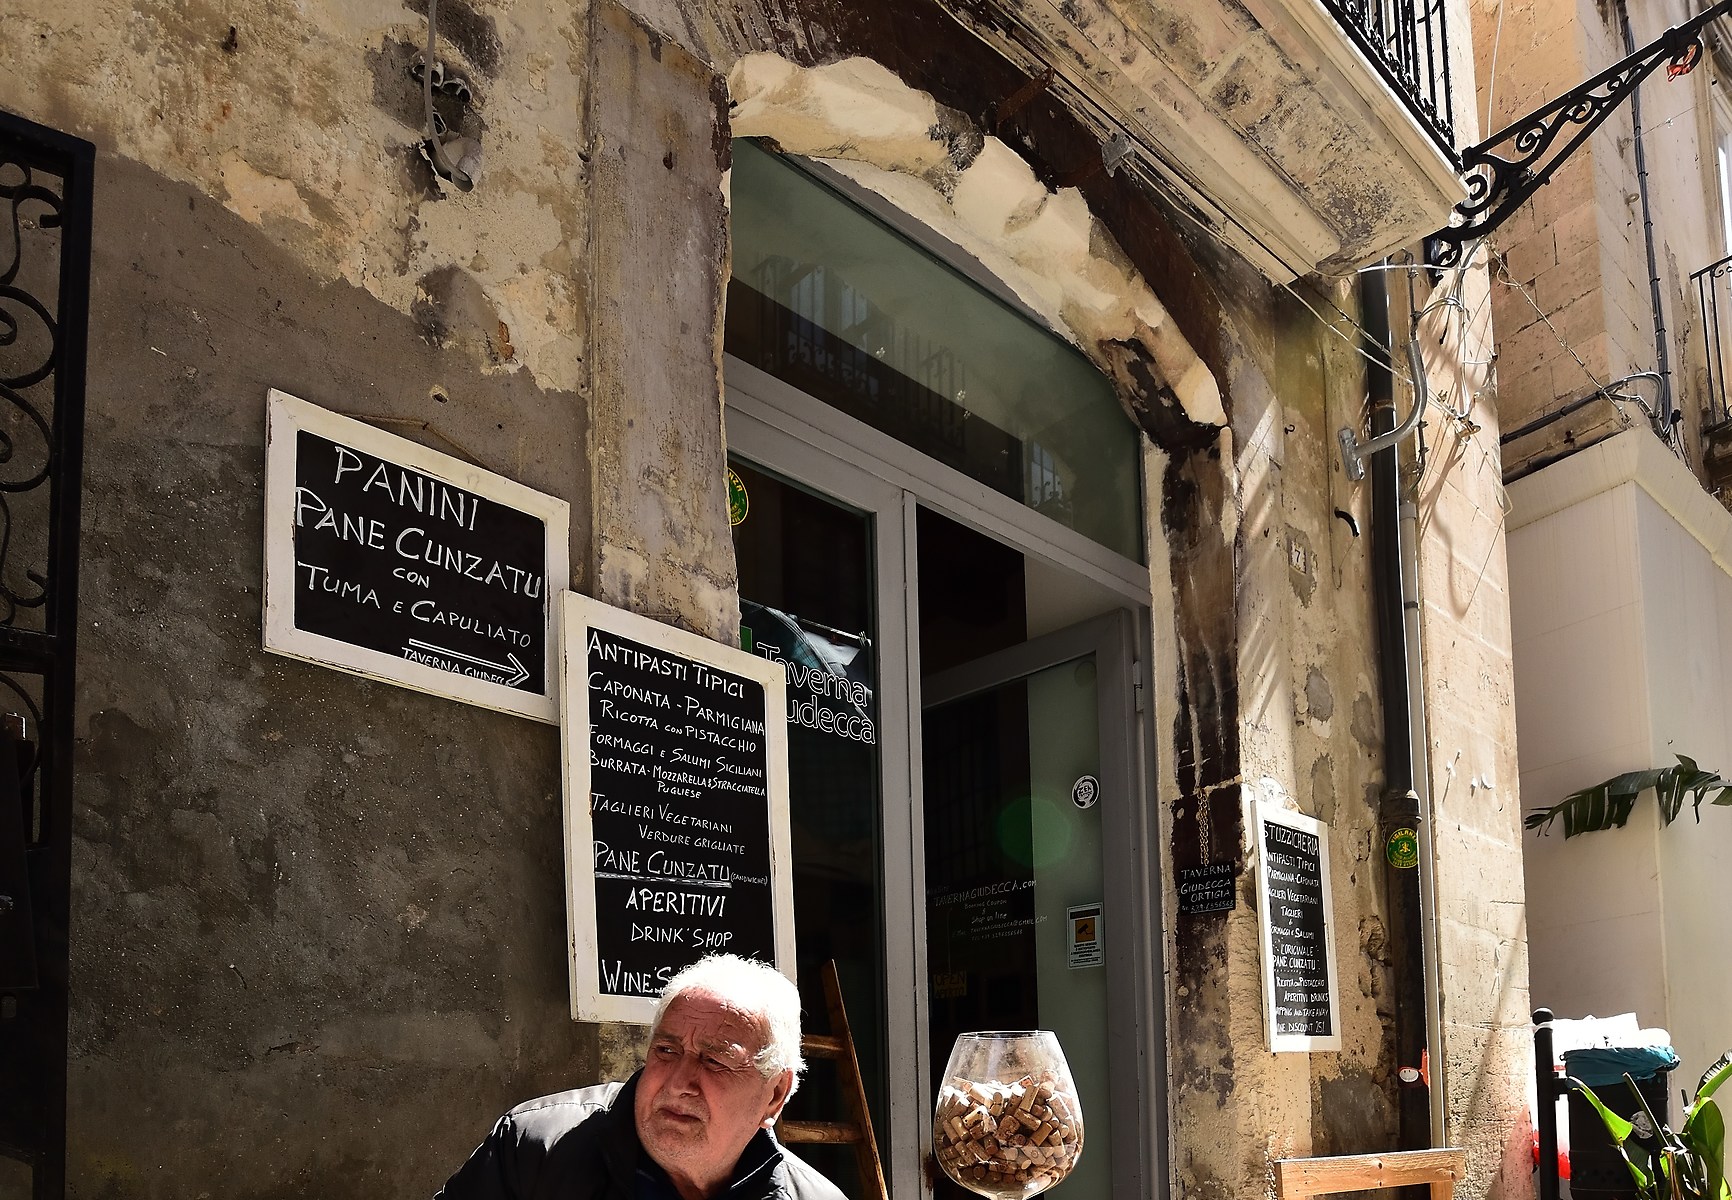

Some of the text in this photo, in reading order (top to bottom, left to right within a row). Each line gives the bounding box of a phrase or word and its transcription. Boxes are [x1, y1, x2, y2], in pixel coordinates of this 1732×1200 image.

[334, 446, 479, 531] PANINI
[295, 486, 541, 599] PANE CUNZATU
[1294, 548, 1301, 563] 7
[392, 567, 431, 589] CON
[297, 560, 532, 648] TUMA E CAPULIATO
[401, 647, 461, 674] TAVERNA
[587, 631, 744, 699] ANTIPASTI TIPICI
[587, 671, 671, 710] CAPONATA
[684, 695, 766, 737] PARMIGIANA
[600, 699, 659, 730] RICOTTA
[684, 725, 757, 753] PISTACCHIO
[590, 723, 763, 778] FORMAGGI E SALUMI SICILIANI
[656, 780, 703, 799] PUGLIESE
[590, 792, 733, 834] TAGLIERI VEGETARIANI
[638, 823, 746, 855] VERDURE GRIGLIATE
[1263, 823, 1320, 857] STUZZICHERIA
[592, 840, 640, 874] PANE
[647, 850, 731, 881] CUNZATU
[1180, 864, 1232, 880] TAVERNA
[1296, 856, 1316, 872] TIPICI
[625, 886, 726, 918] APERITIVI
[1180, 878, 1232, 895] GIUDECCA
[1190, 889, 1231, 903] ORTIGIA
[1272, 954, 1317, 971] PANE CUNZATU
